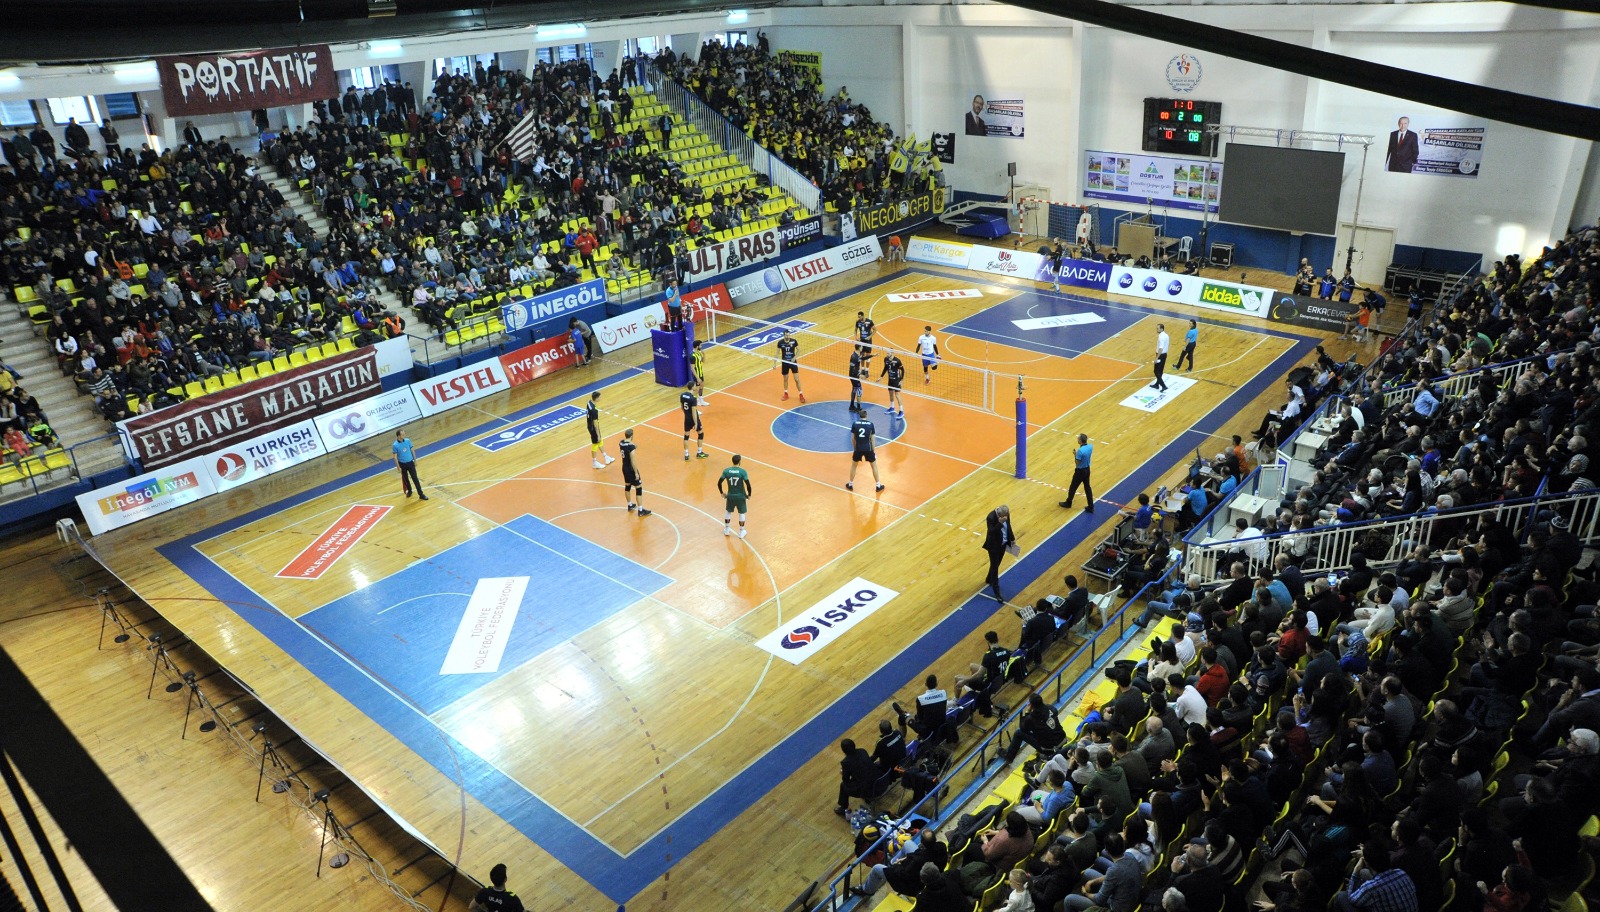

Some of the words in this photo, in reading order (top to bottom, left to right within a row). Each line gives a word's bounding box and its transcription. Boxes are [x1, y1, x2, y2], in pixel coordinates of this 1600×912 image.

[1165, 131, 1173, 139] 10
[1188, 132, 1199, 141] 08
[785, 257, 833, 283] VESTEL
[531, 287, 602, 320] İNEGÖL
[693, 292, 720, 311] TVF
[1203, 287, 1241, 305] iddaa
[617, 323, 638, 338] TVF
[259, 360, 373, 418] MARATON
[420, 367, 502, 406] VESTEL
[393, 398, 408, 407] CAM
[684, 402, 689, 410] 5
[140, 402, 249, 459] EFSANE
[858, 428, 866, 437] 2
[246, 428, 312, 457] TURKISH
[254, 440, 317, 471] AIRLINES
[164, 476, 190, 492] AVM
[729, 477, 739, 486] 17
[301, 546, 339, 576] VOLEYBOL
[473, 630, 496, 670] VOLEYBOL
